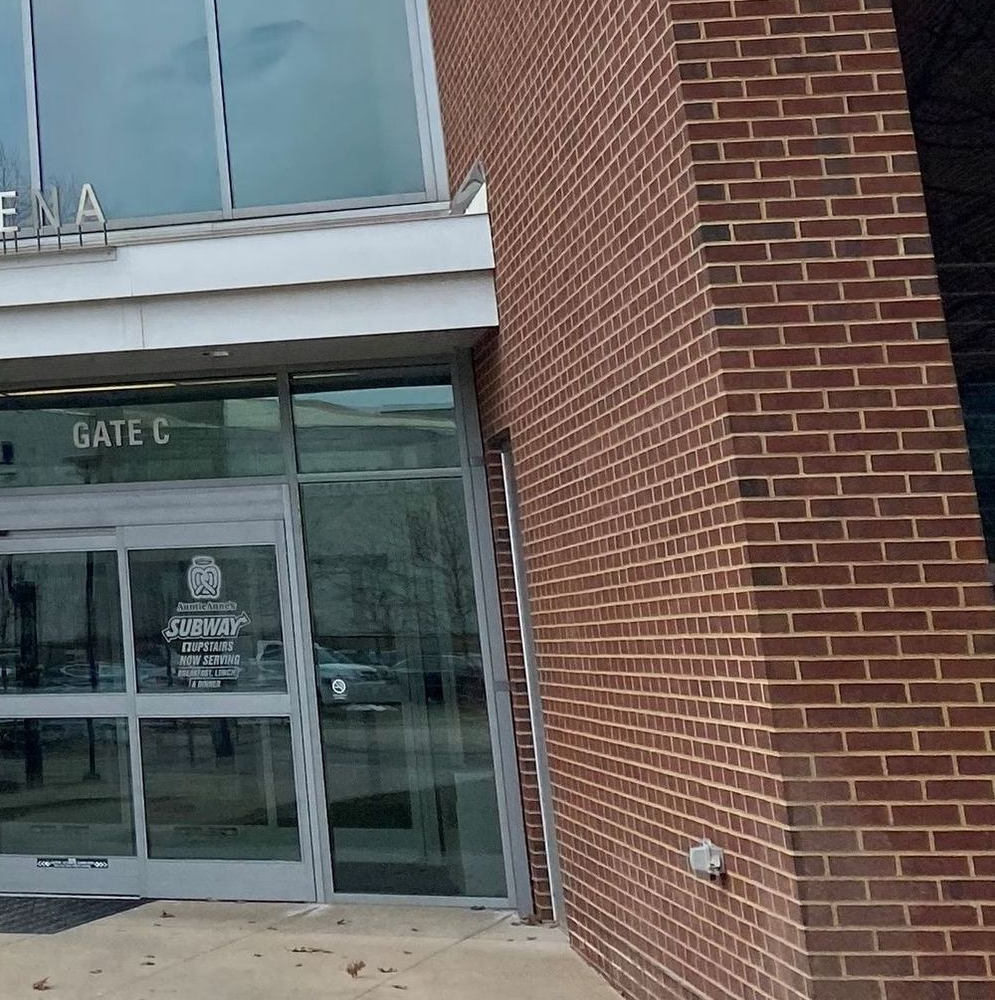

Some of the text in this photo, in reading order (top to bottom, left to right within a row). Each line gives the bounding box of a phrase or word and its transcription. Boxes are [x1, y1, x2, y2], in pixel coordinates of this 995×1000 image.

[72, 417, 171, 449] GATE C
[165, 616, 247, 637] SUBWAY
[192, 641, 234, 653] UPSTAIRS
[179, 654, 240, 666] NOW SERVING
